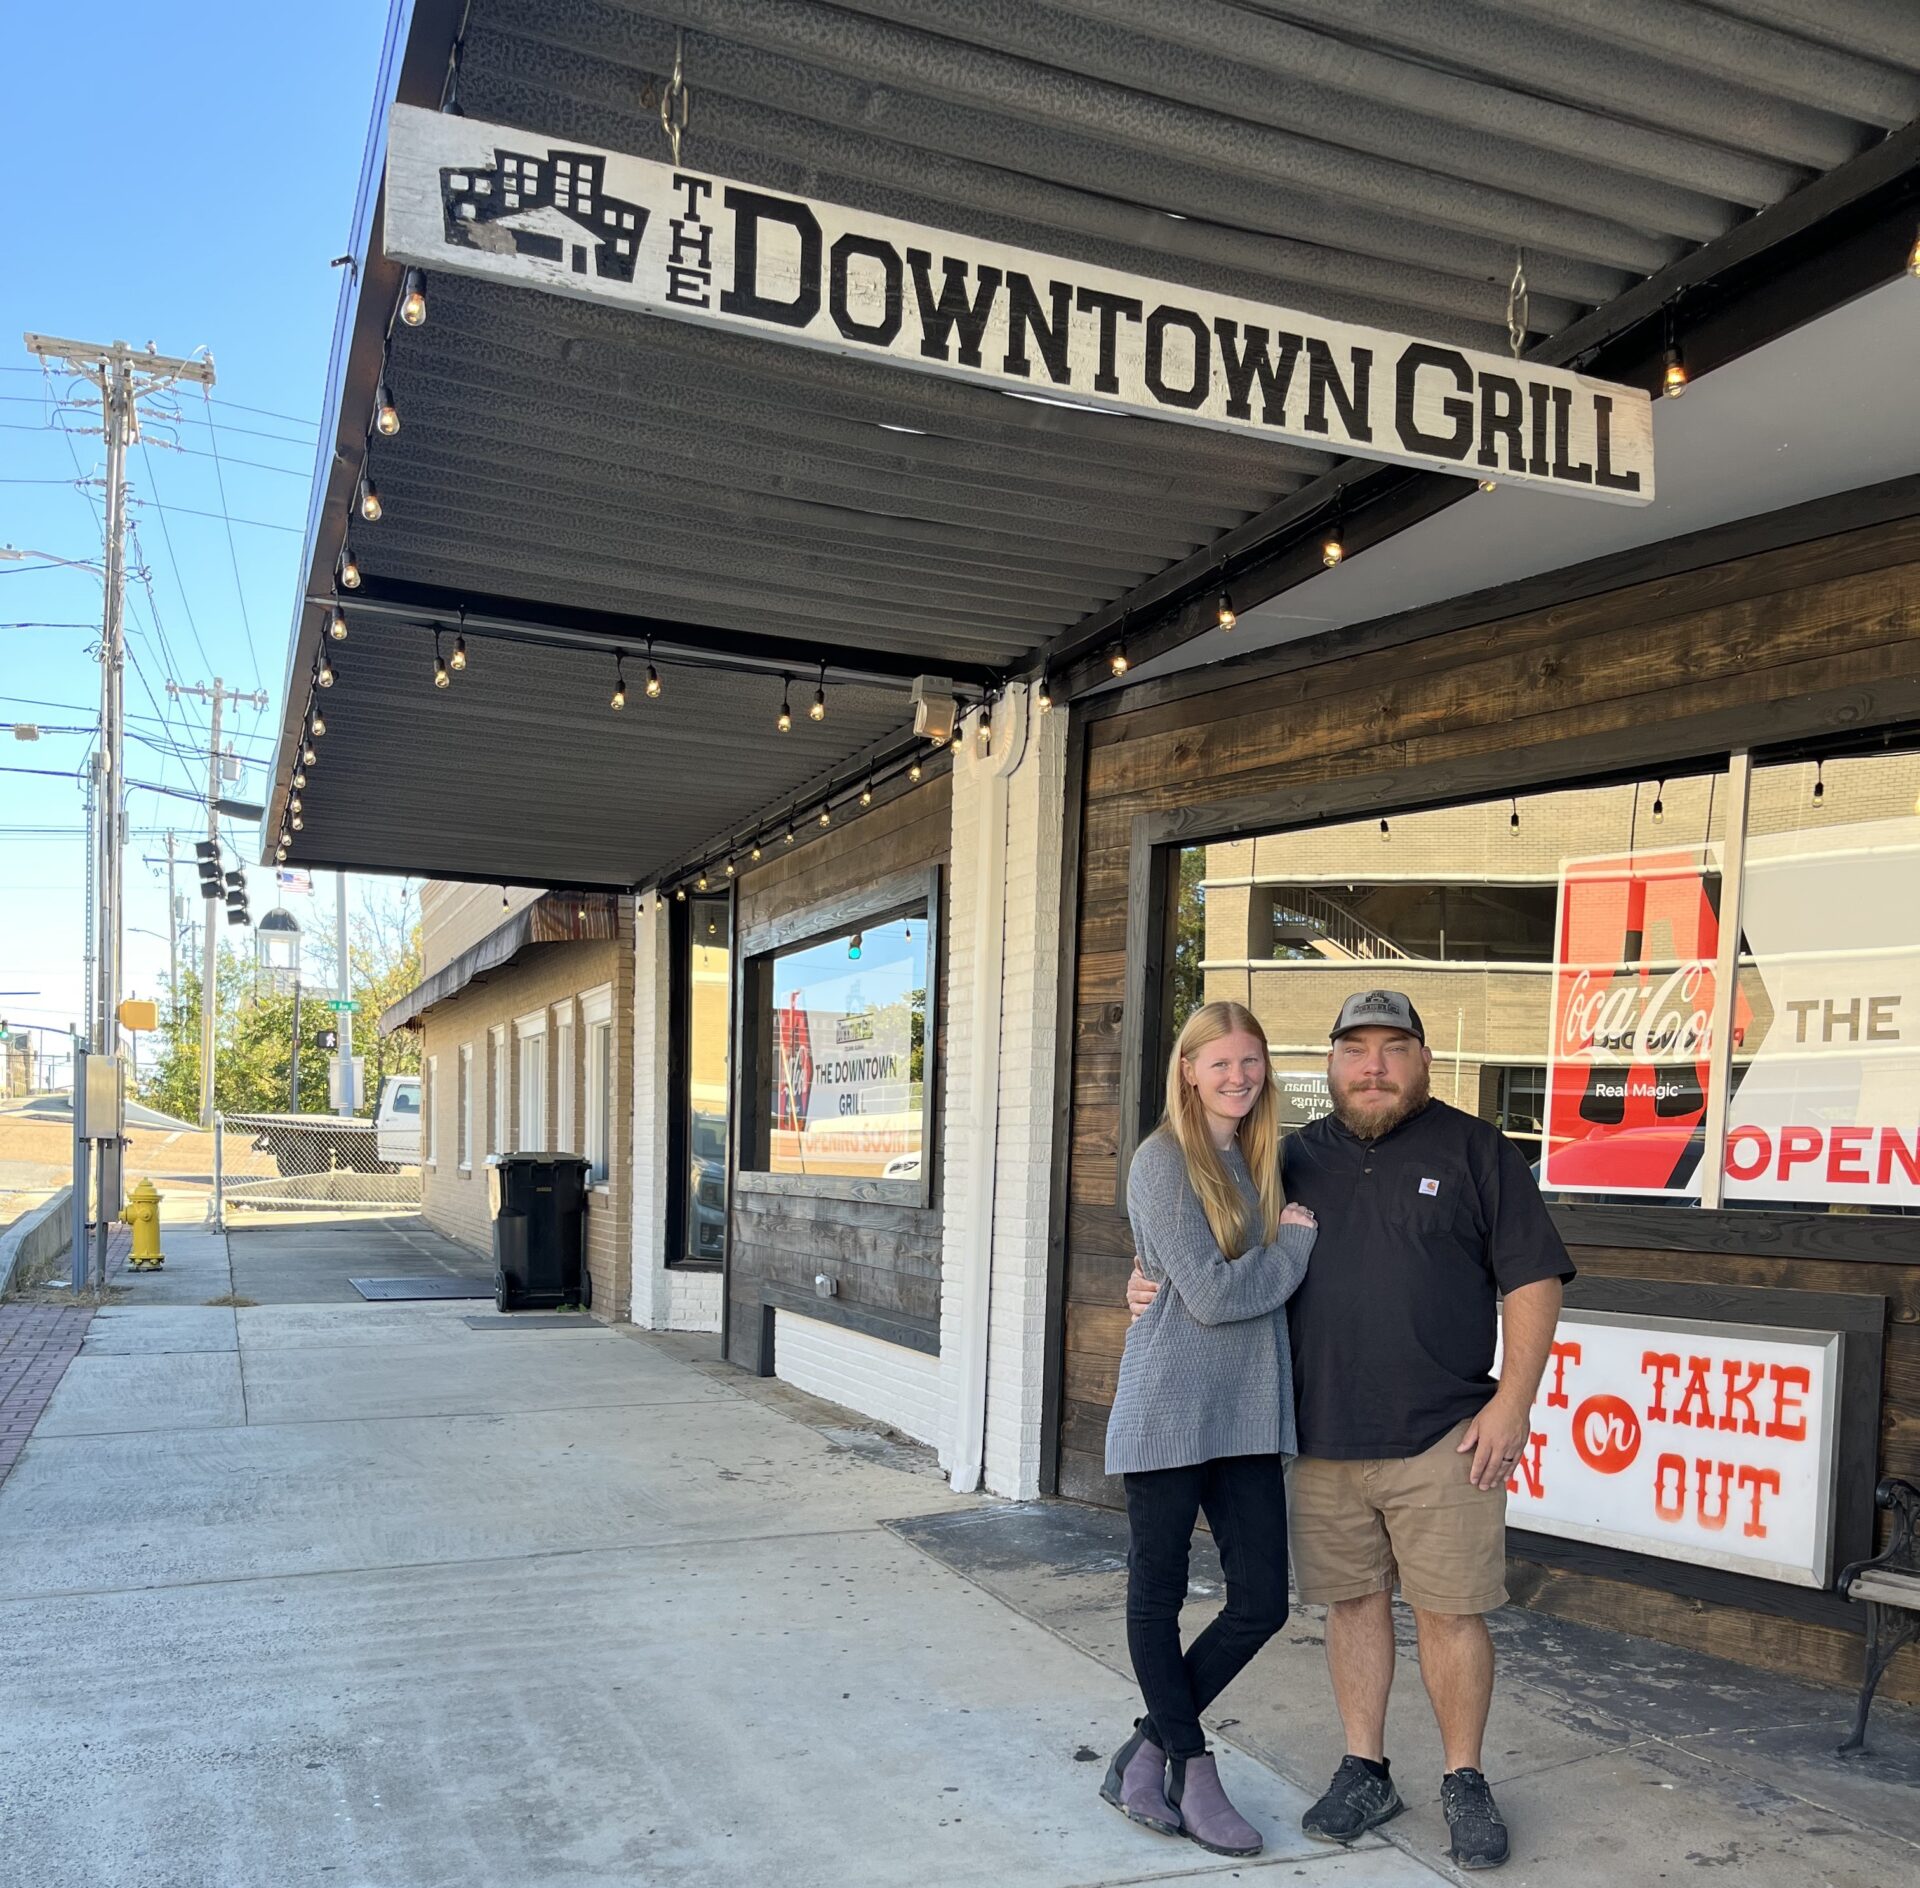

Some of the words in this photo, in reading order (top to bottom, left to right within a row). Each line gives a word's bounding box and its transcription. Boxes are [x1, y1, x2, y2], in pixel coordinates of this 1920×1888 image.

[667, 172, 712, 308] THE
[720, 186, 1374, 443] DOWNTOWN
[1395, 342, 1641, 493] GRILL
[1786, 995, 1902, 1043] THE
[815, 1063, 833, 1085] THE
[835, 1053, 897, 1083] DOWNTOWN
[1595, 1083, 1628, 1097] Real
[839, 1093, 867, 1116] GRILL
[1641, 1350, 1810, 1442] TAKE
[1653, 1452, 1780, 1539] OUT
